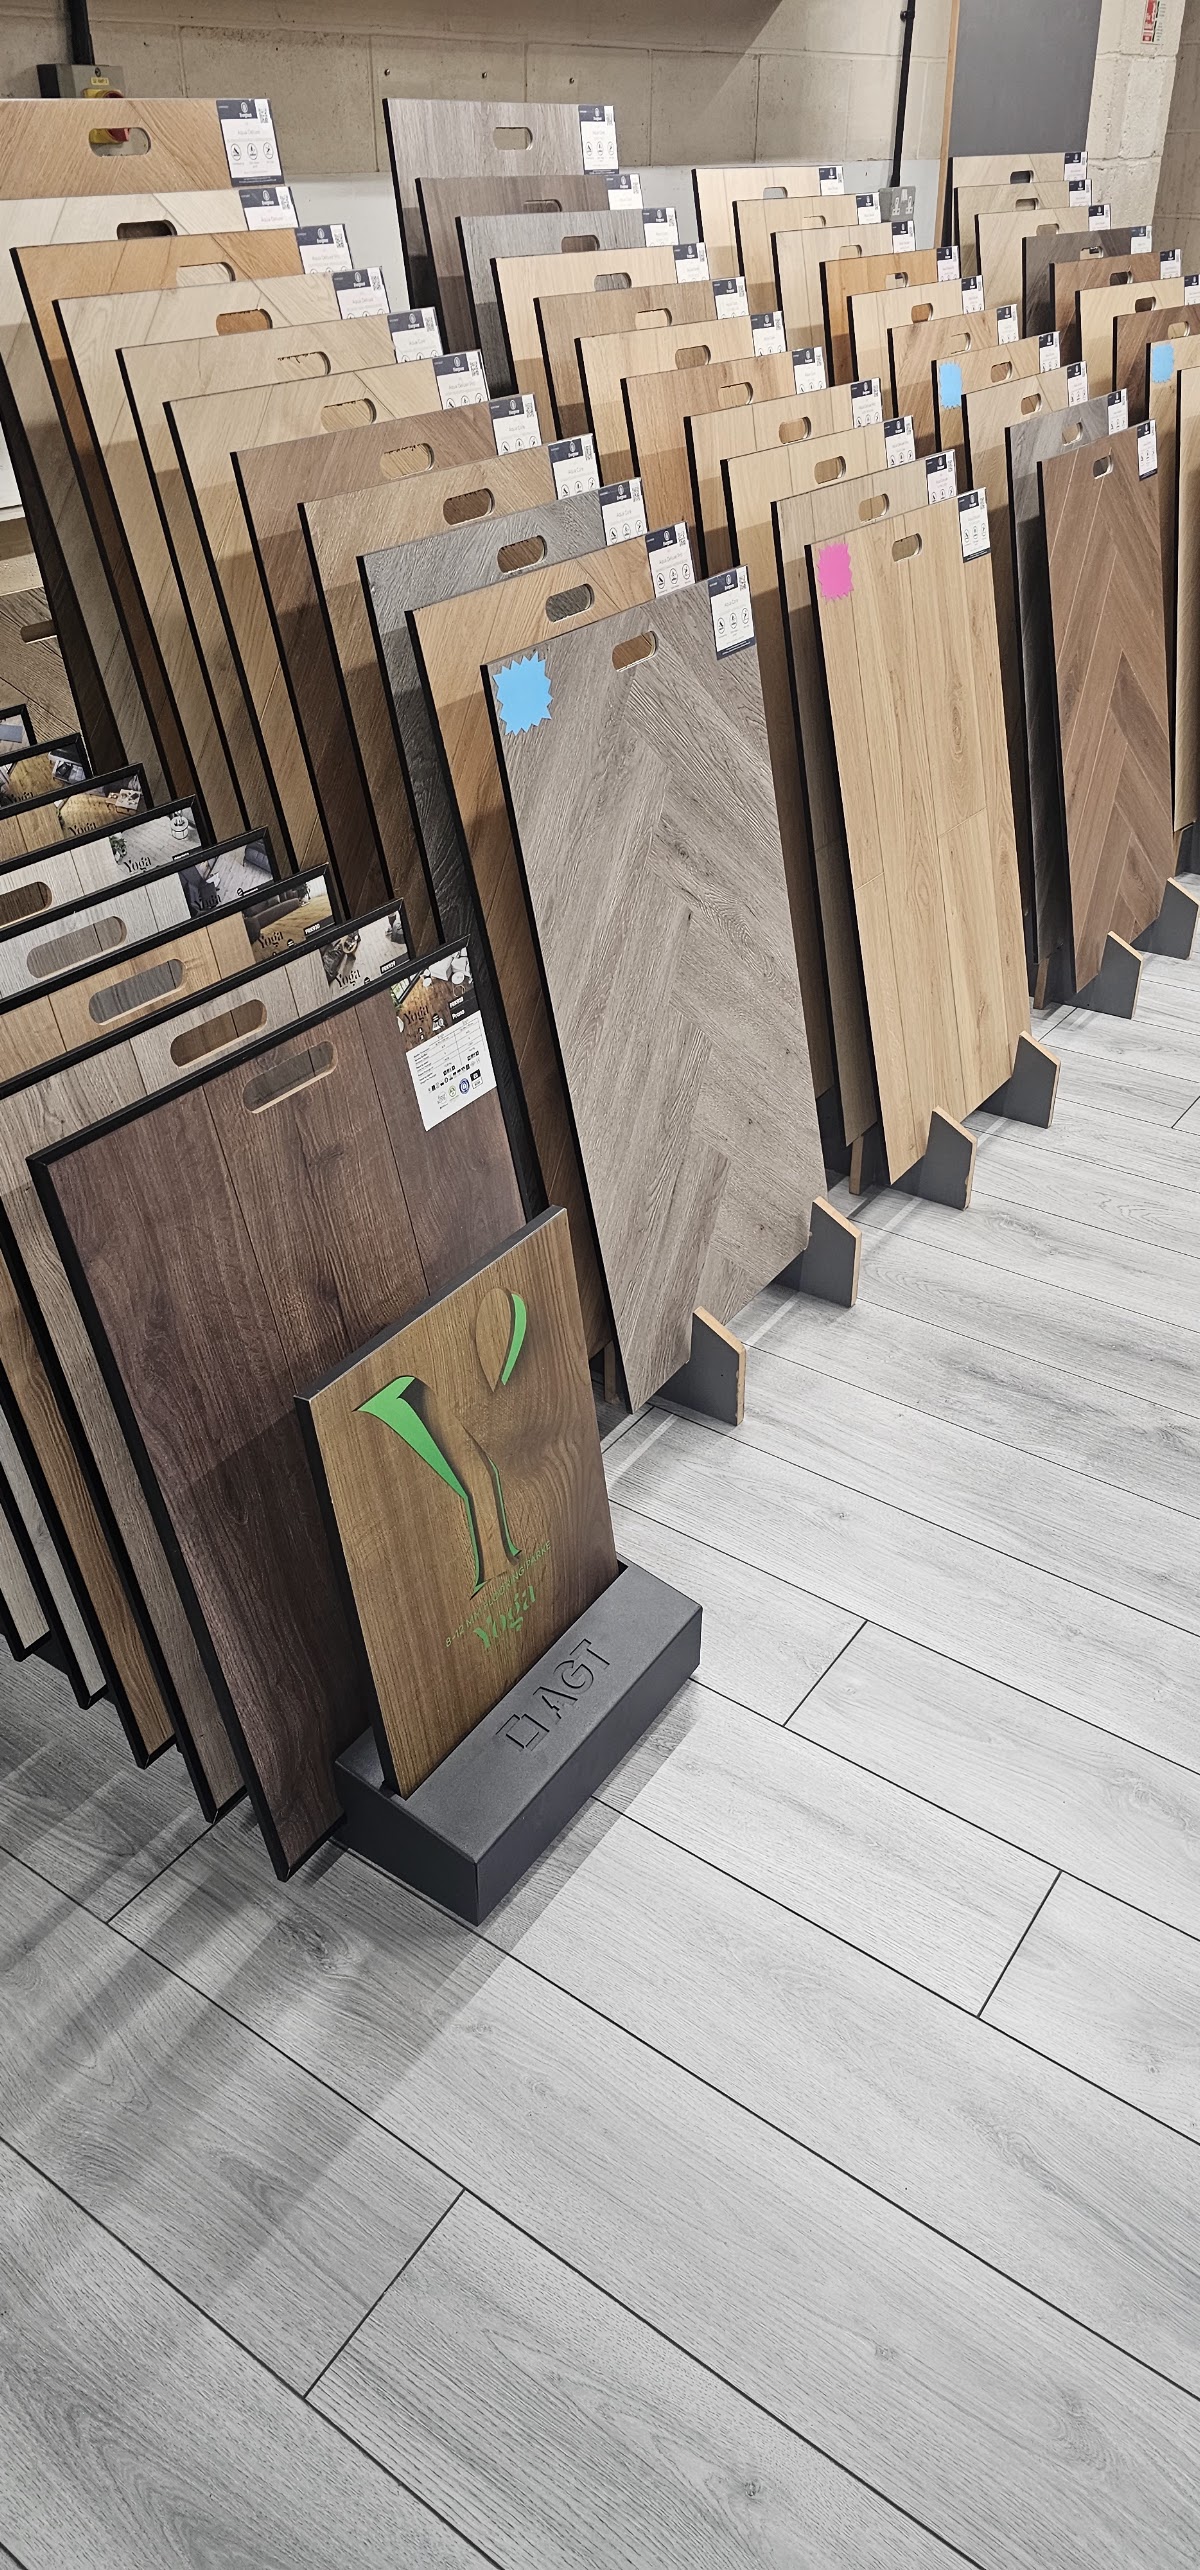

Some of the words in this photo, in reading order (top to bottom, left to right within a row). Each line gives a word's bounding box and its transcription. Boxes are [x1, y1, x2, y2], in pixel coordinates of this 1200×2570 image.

[124, 856, 152, 874] Yoga
[258, 931, 284, 949] Yoga
[335, 969, 361, 989] Yoga
[403, 1005, 430, 1025] Yoga
[525, 1540, 551, 1571] PARKE
[473, 1585, 536, 1649] Yoga
[532, 1637, 611, 1724] AGT
